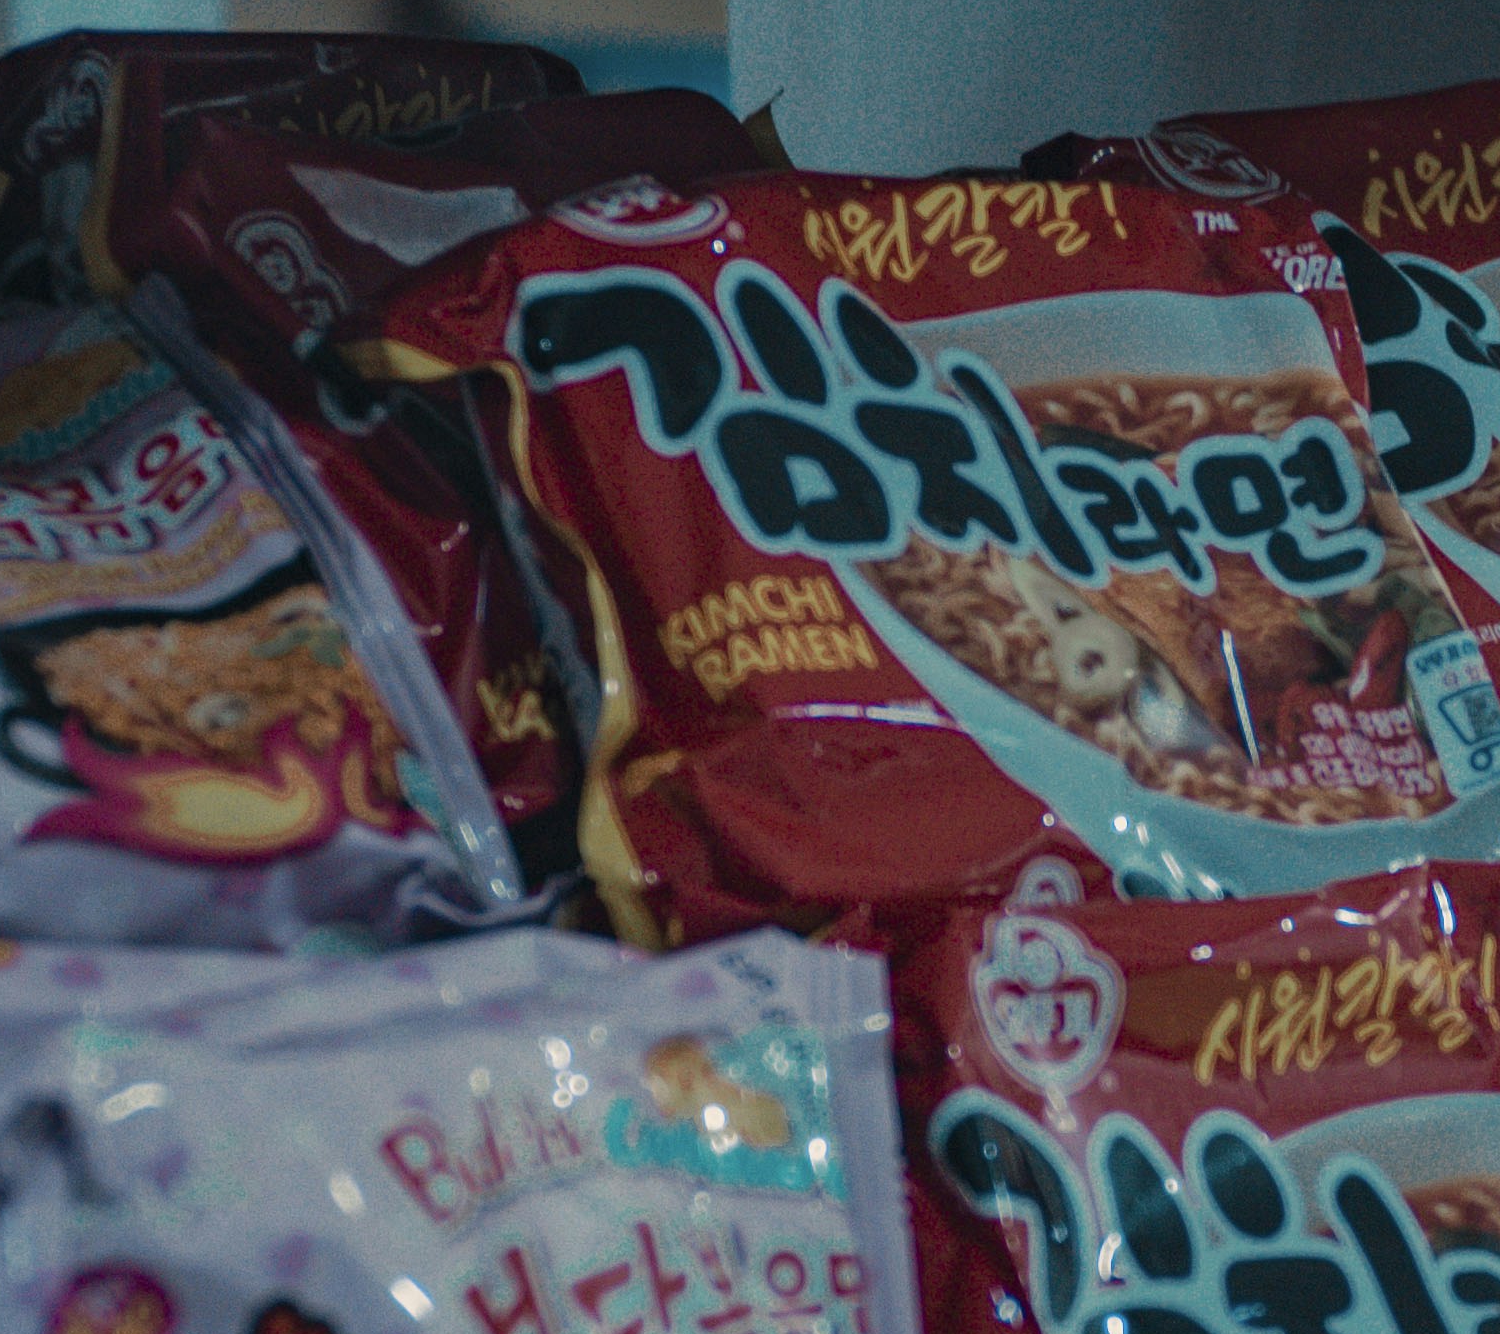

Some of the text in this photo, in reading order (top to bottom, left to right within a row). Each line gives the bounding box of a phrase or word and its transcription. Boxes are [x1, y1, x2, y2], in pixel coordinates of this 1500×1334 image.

[517, 261, 1386, 593] 김치라면
[657, 572, 843, 671] KIMCHI
[702, 624, 878, 705] RAMEN
